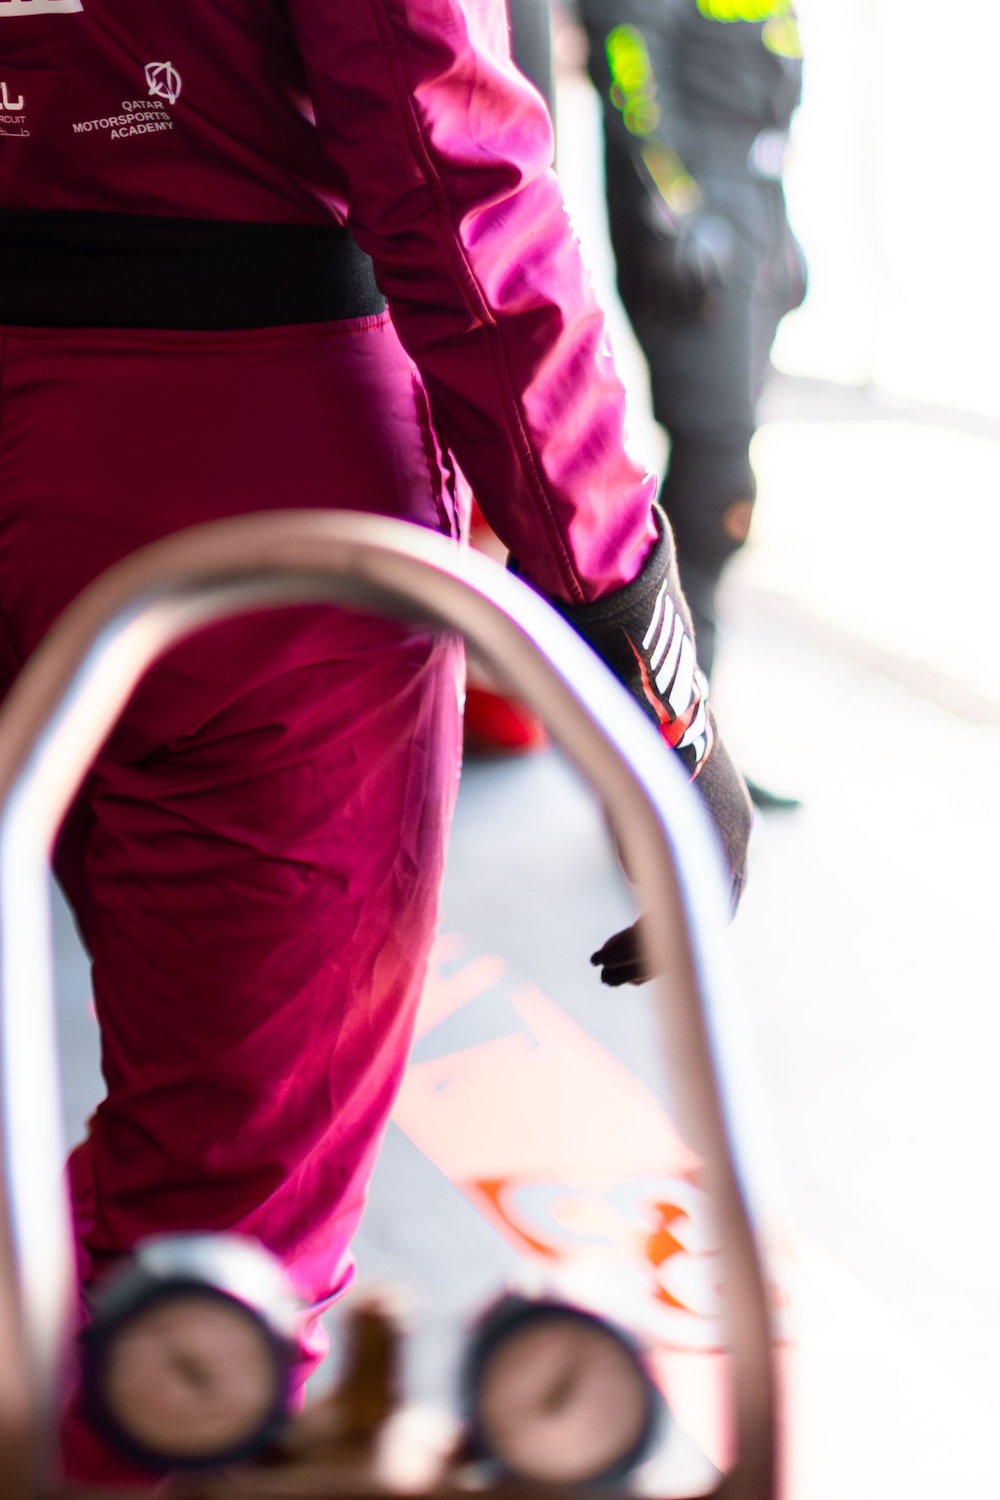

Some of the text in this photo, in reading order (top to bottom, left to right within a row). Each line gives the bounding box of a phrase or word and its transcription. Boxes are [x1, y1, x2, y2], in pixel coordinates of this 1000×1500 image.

[121, 100, 165, 112] QATAR
[72, 111, 170, 133] MOTORSPORTS
[110, 122, 173, 140] ACADEMY
